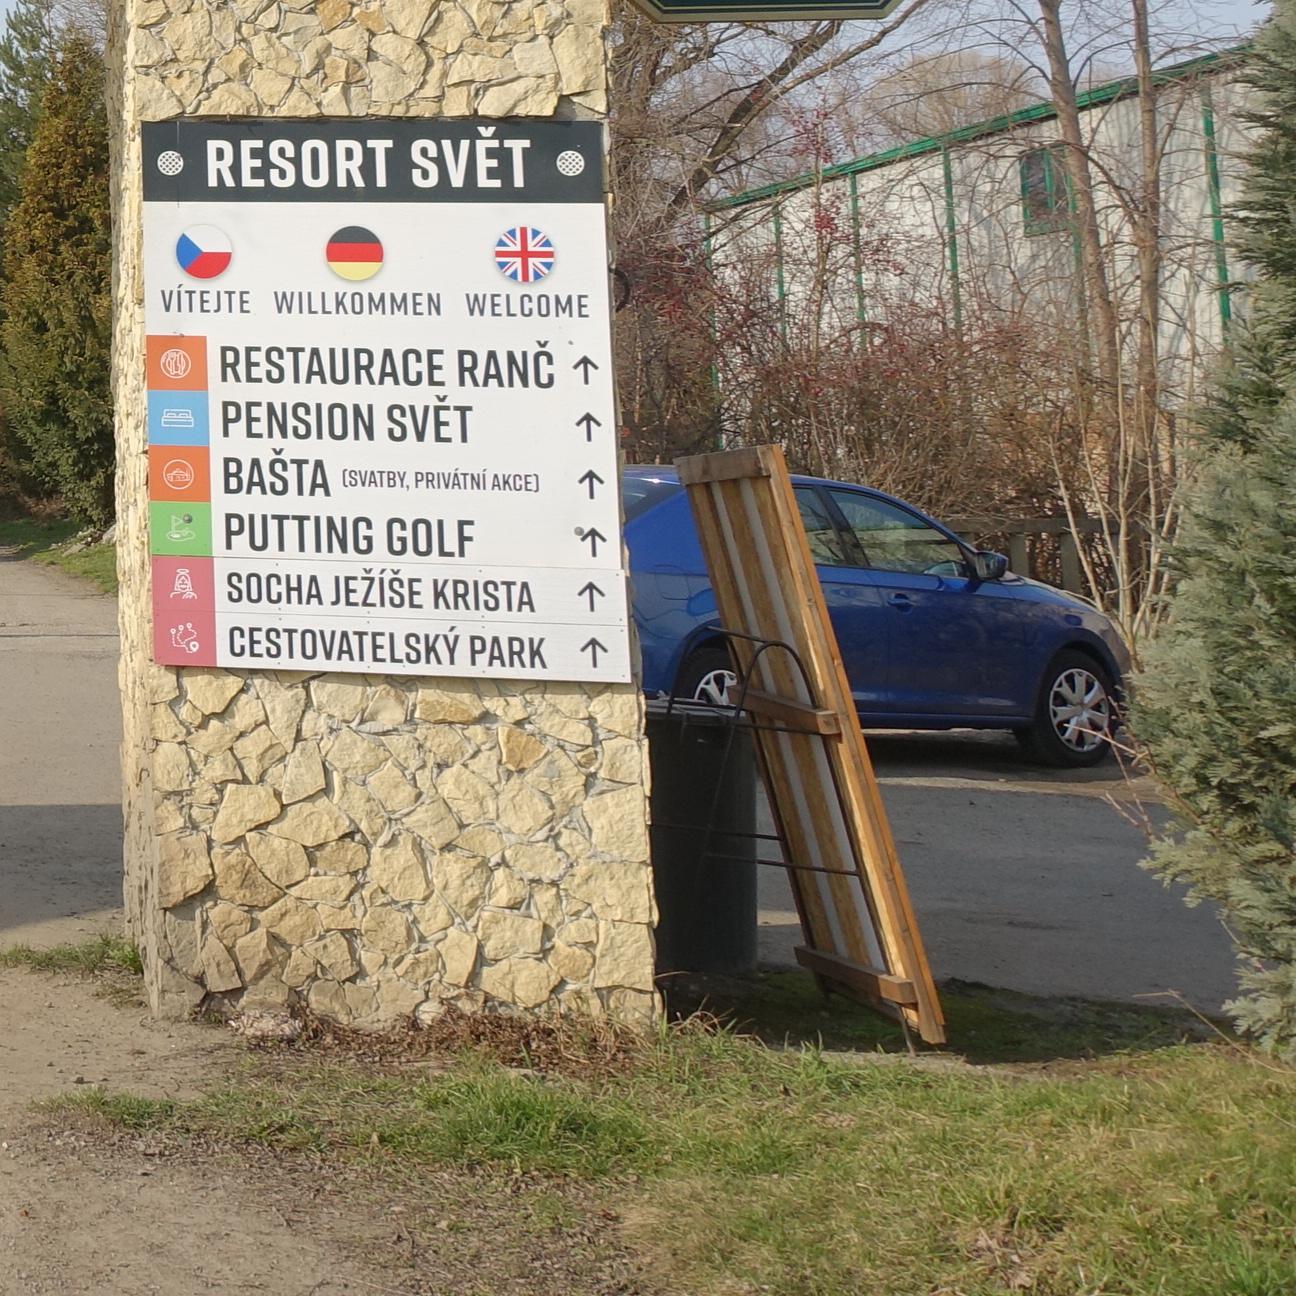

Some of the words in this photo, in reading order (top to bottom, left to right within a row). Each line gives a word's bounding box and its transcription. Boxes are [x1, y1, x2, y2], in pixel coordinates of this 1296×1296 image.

[207, 139, 393, 188] RESORT
[411, 127, 531, 188] SVĚT
[161, 284, 250, 314] VÍTEJTE
[274, 291, 441, 316] WILLKOMMEN
[466, 293, 590, 318] WELCOME
[220, 345, 445, 387] RESTAURACE
[458, 341, 555, 389] RANČ
[222, 401, 375, 442] PENSION
[387, 395, 473, 443] SVĚT
[223, 448, 331, 497] BAŠTA
[415, 468, 487, 491] PRIVÁTNÍ
[224, 513, 374, 556] PUTTING
[387, 518, 475, 558] GOLF
[227, 572, 323, 606] SOCHA
[331, 568, 423, 610] JEŽÍŠE
[433, 579, 536, 613] KRISTA
[229, 626, 459, 667] CESTOVATELSKÝ
[470, 635, 547, 670] PARK
